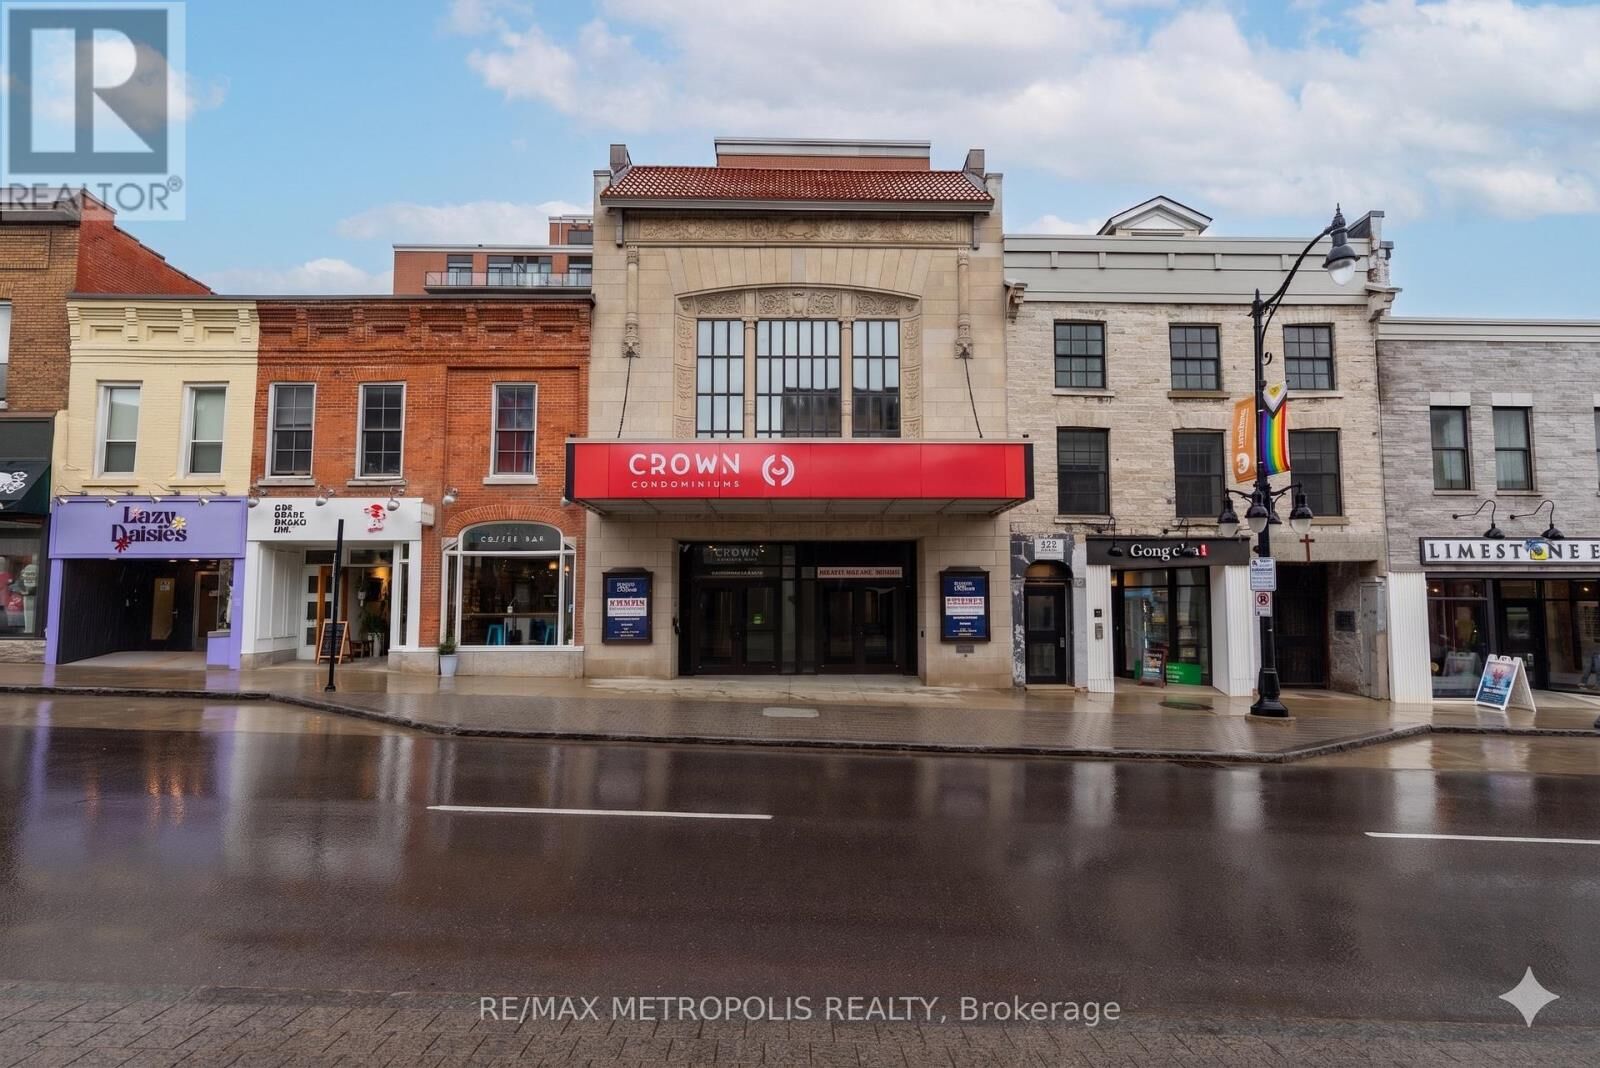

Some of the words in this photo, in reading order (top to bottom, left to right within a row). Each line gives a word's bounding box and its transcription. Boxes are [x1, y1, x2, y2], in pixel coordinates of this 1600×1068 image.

[629, 453, 740, 476] CROWN
[123, 506, 176, 529] Lazy
[112, 524, 187, 542] Daisies
[525, 535, 544, 543] BAR
[715, 548, 760, 557] CROWN
[1130, 543, 1171, 561] Gong
[1429, 543, 1580, 559] LIMESTNE
